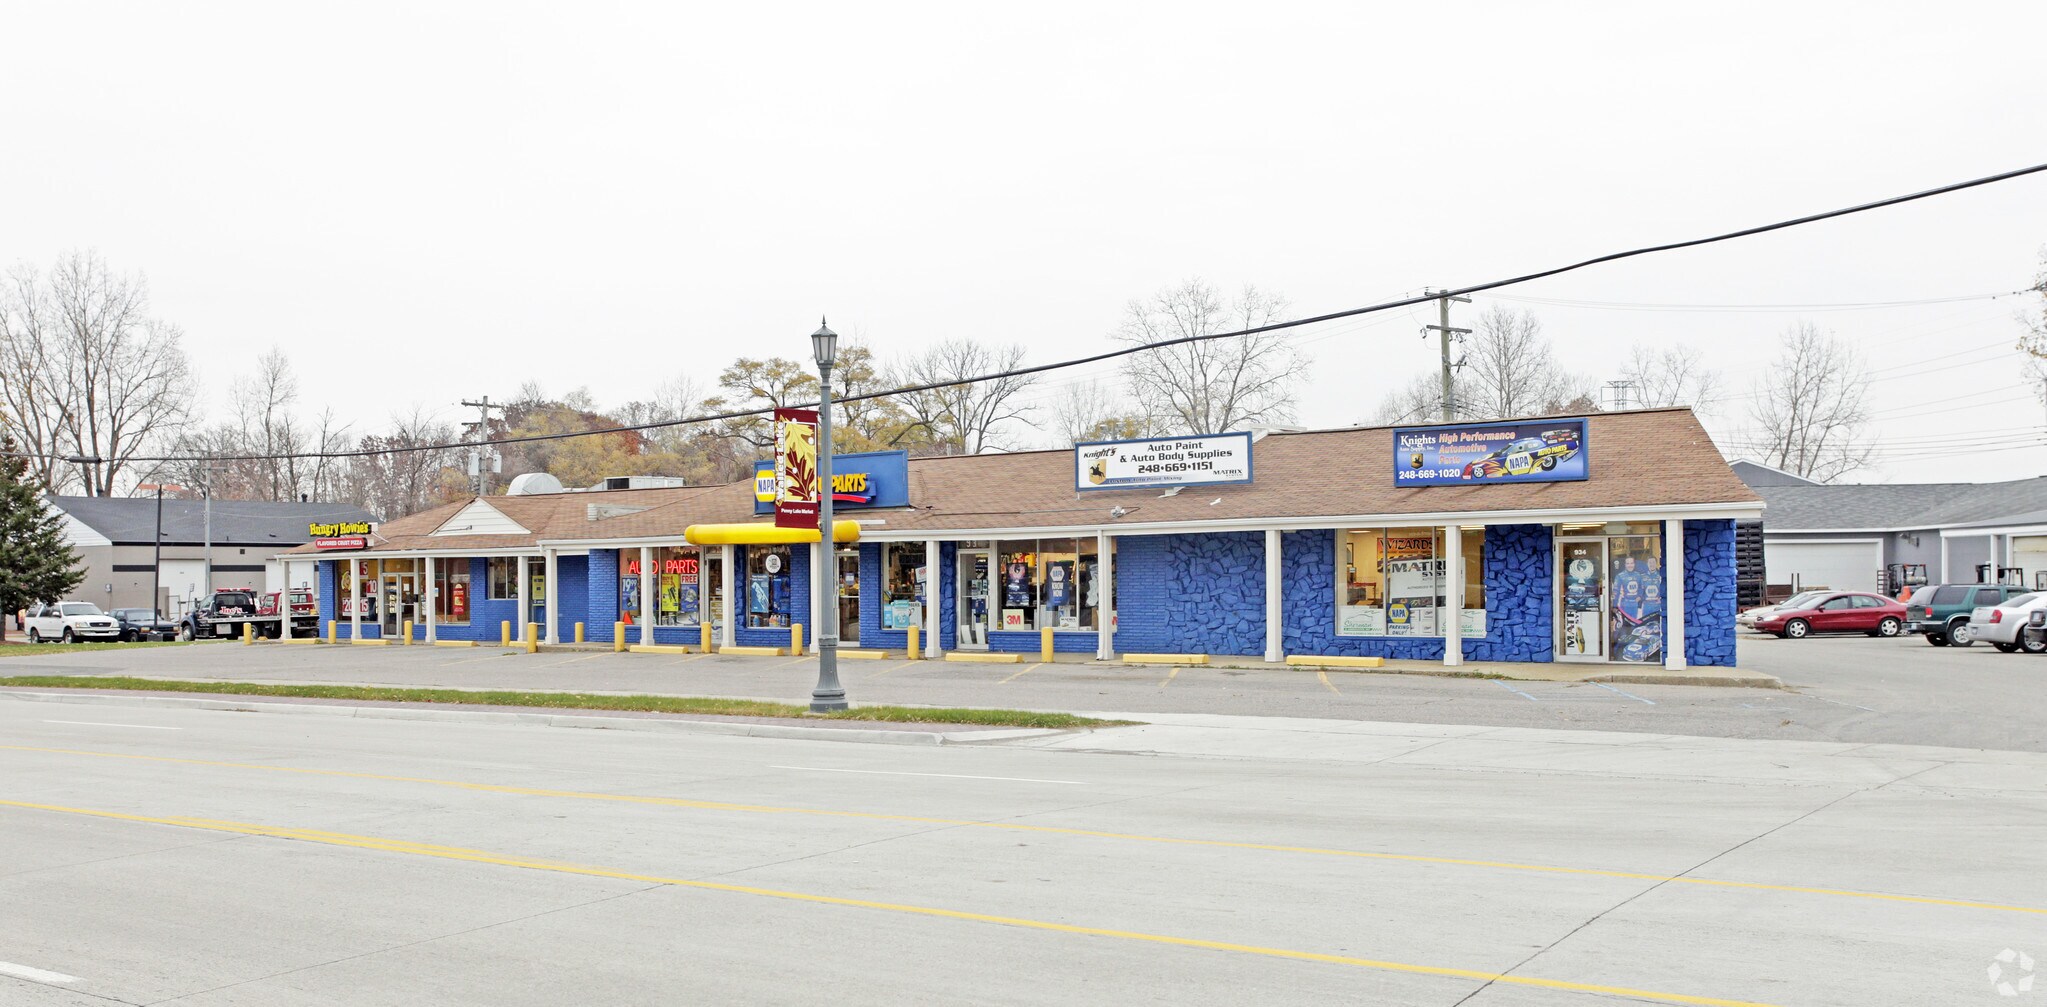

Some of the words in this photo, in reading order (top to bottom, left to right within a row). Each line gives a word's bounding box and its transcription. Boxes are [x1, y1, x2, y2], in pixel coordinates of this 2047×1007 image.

[1400, 434, 1436, 447] Knights
[1439, 433, 1458, 444] High
[1460, 431, 1516, 442] Performance
[1083, 446, 1117, 459] Knight's
[1147, 443, 1172, 452] Auto
[1175, 442, 1203, 450] Paint
[1439, 443, 1487, 454] Automotive
[1537, 448, 1551, 457] AUTO
[1552, 444, 1567, 454] PARTS
[1119, 455, 1127, 463] &
[1130, 454, 1155, 463] Auto
[1158, 452, 1184, 462] Body
[1187, 449, 1232, 460] Supplies
[1439, 456, 1460, 464] Parts
[1509, 456, 1529, 469] NAPA
[1399, 469, 1460, 480] 248-669-1020
[757, 479, 775, 493] NAPA
[310, 522, 339, 537] Hungry
[340, 521, 369, 534] Howie's
[629, 560, 659, 575] AUO
[666, 560, 698, 574] PARTS
[1392, 561, 1447, 573] MATRI
[1391, 608, 1406, 618] NAPA
[1006, 615, 1021, 625] 3M
